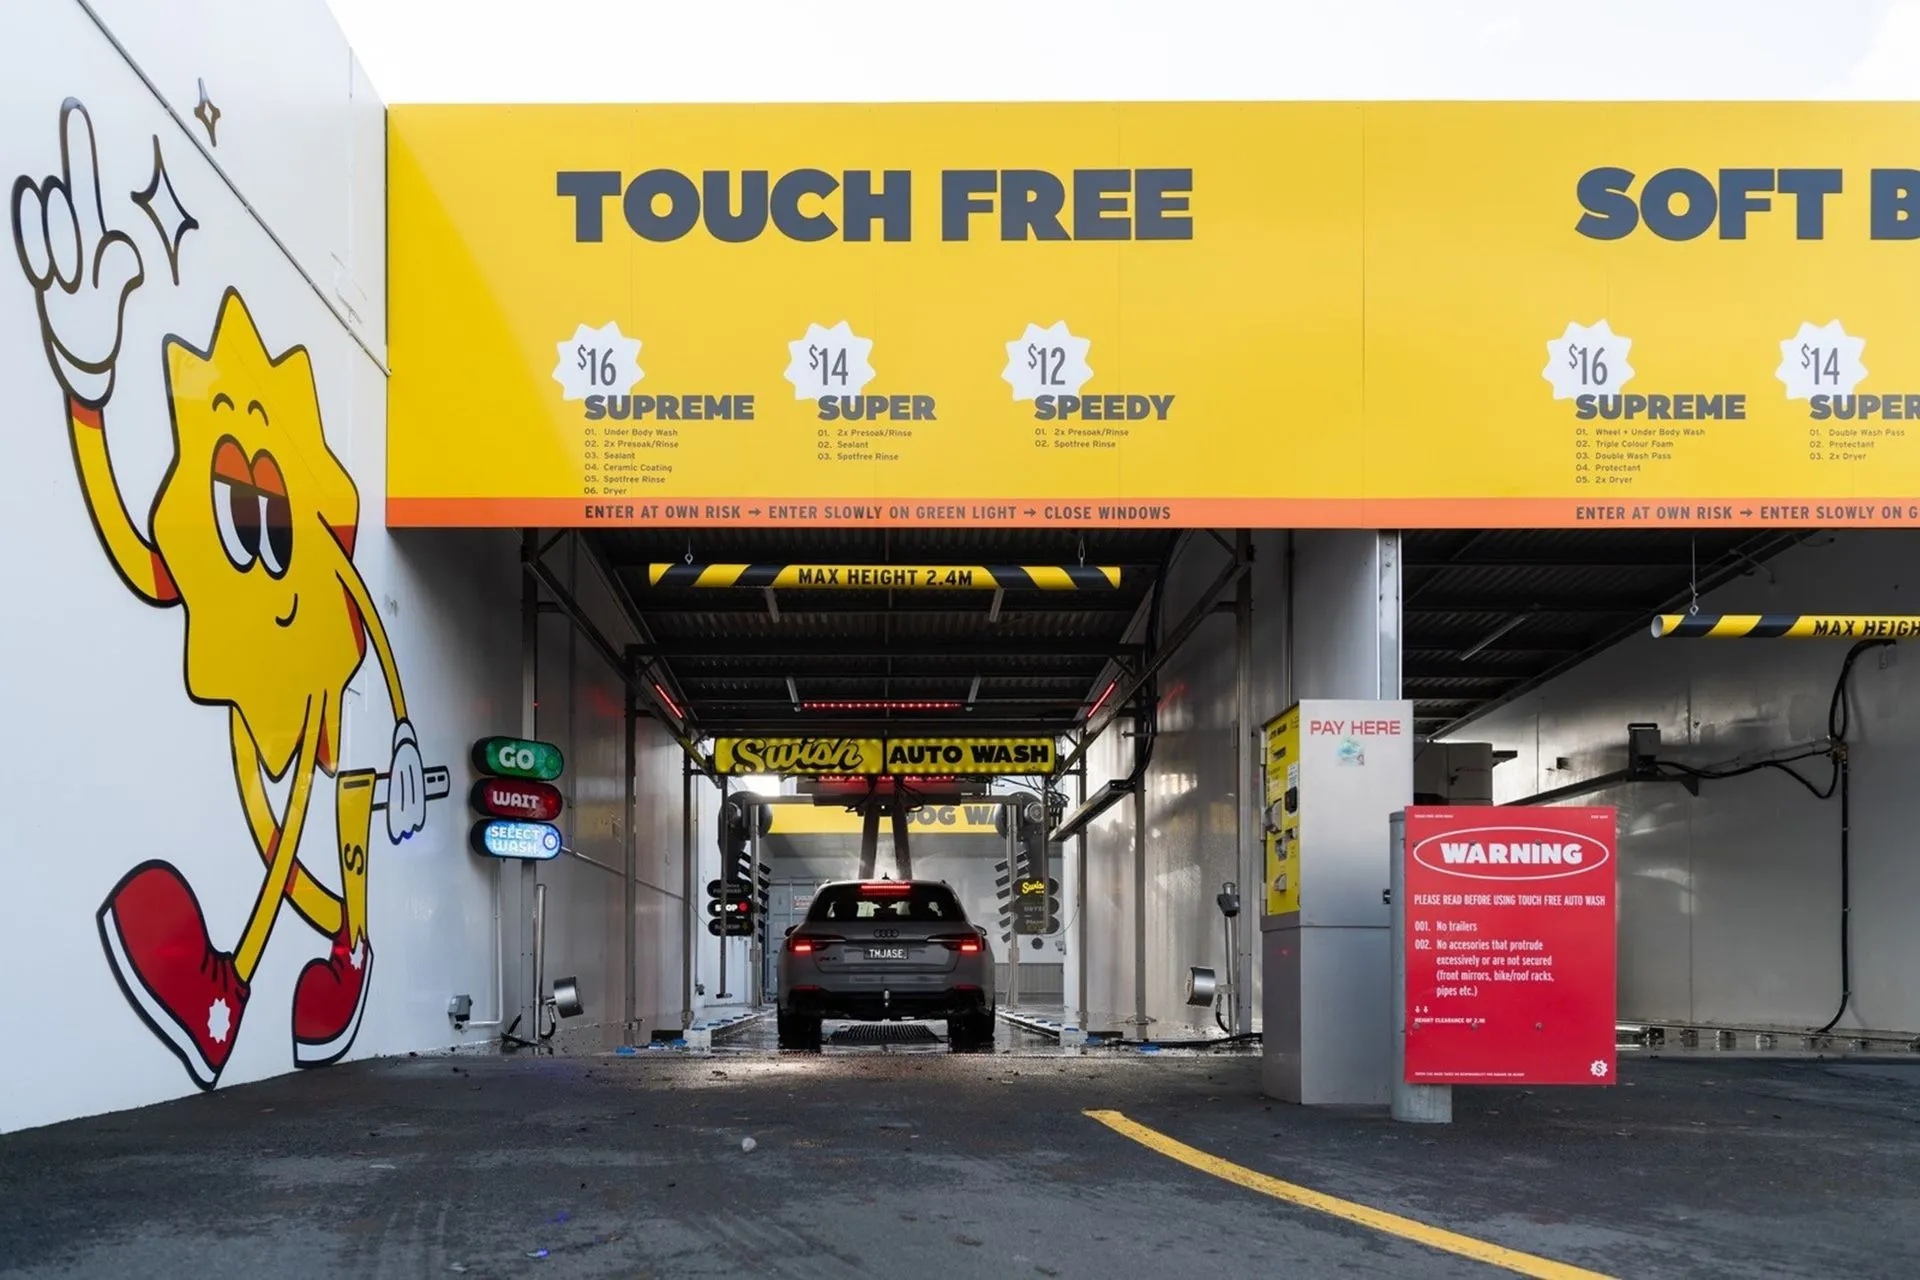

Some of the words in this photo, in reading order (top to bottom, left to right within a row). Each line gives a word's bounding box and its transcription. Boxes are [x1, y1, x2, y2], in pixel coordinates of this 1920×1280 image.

[556, 168, 911, 243] TOUCH
[941, 168, 1193, 241] FREE
[1575, 167, 1843, 241] SOFT
[578, 344, 616, 386] $16
[809, 344, 848, 385] $14
[1028, 343, 1065, 385] $12
[1569, 344, 1607, 385] $16
[1801, 343, 1840, 385] $14
[584, 395, 755, 421] SUPREME
[817, 395, 937, 421] SUPER
[1034, 395, 1175, 421] SPEEDY
[1575, 394, 1746, 420] SUPREME
[1809, 394, 1920, 420] SUPER
[632, 428, 653, 437] Body
[818, 429, 830, 437] 01.
[851, 429, 912, 437] Presoak/Rinse
[1054, 428, 1065, 436] 2x
[1068, 428, 1129, 436] Presoak/Rinse
[1659, 428, 1680, 437] Body
[1808, 428, 1820, 436] 01.
[1885, 428, 1904, 436] Pass
[618, 440, 679, 448] Presoak/Rinse
[1055, 440, 1089, 448] Spotfree
[1093, 440, 1116, 448] Rinse
[1596, 440, 1619, 449] Triple
[1621, 440, 1648, 448] Colour
[1809, 440, 1824, 448] 02.
[604, 452, 635, 460] Sealant
[818, 452, 832, 460] 03.
[837, 452, 873, 461] Spotfree
[1596, 452, 1624, 460] Double
[1809, 452, 1823, 460] 03.
[1829, 452, 1839, 460] 2x
[603, 463, 637, 473] Ceramic
[640, 464, 672, 473] Coating
[603, 475, 639, 484] Spotfree
[1596, 476, 1606, 484] 2x
[1609, 476, 1632, 484] Dryer
[603, 487, 627, 496] Dryer
[585, 506, 633, 518] ENTER
[641, 506, 658, 518] AT
[665, 506, 698, 518] OWN
[706, 506, 740, 519] RISK
[769, 506, 817, 519] ENTER
[825, 506, 882, 519] SLOWLY
[889, 506, 909, 519] ON
[916, 506, 965, 519] GREEN
[973, 506, 1016, 519] LIGHT
[1045, 506, 1091, 519] CLOSE
[1099, 506, 1170, 520] WINDOWS
[1576, 507, 1625, 520] ENTER
[1632, 507, 1650, 519] AT
[1657, 507, 1690, 519] OWN
[1697, 506, 1732, 519] RISK
[1761, 506, 1809, 519] ENTER
[1816, 506, 1875, 519] SLOWLY
[1882, 506, 1901, 519] ON
[799, 568, 839, 587] MAX
[847, 568, 919, 587] HEIGHT
[925, 568, 973, 587] 2.4M
[1812, 620, 1856, 636] MAX
[1311, 721, 1344, 735] PAY
[1351, 721, 1400, 735] HERE
[498, 746, 535, 771] GO
[732, 737, 864, 772] Swish
[889, 745, 962, 763] AUTO
[972, 745, 1047, 763] WASH
[492, 791, 540, 809] WAIT
[964, 805, 995, 825] W
[491, 826, 540, 839] SELECT
[493, 840, 537, 853] WASH
[1440, 843, 1582, 865] WARNING
[1414, 895, 1440, 905] PLEASE
[1443, 895, 1462, 905] READ
[1464, 895, 1491, 905] BEFORE
[1493, 895, 1516, 905] USING
[1518, 895, 1542, 906] TOUCH
[1544, 895, 1562, 906] FREE
[1564, 895, 1583, 906] AUTO
[1585, 895, 1605, 906] WASH
[1415, 921, 1431, 931] 001.
[1437, 921, 1447, 931] No
[1449, 921, 1477, 931] trailers
[1414, 940, 1432, 950] 002.
[1436, 940, 1447, 950] No
[1449, 940, 1489, 950] accesories
[1492, 940, 1507, 950] that
[1510, 940, 1543, 950] protrude
[1436, 956, 1479, 966] excessively
[1482, 956, 1490, 966] or
[1492, 956, 1505, 966] are
[1507, 956, 1519, 966] not
[1522, 956, 1552, 966] secured
[1436, 970, 1458, 981] (front
[1461, 970, 1491, 981] mirrors,
[1494, 970, 1529, 981] bike/roof
[1531, 970, 1554, 981] racks,
[1436, 986, 1457, 997] pipes
[1459, 986, 1478, 997] etc.)
